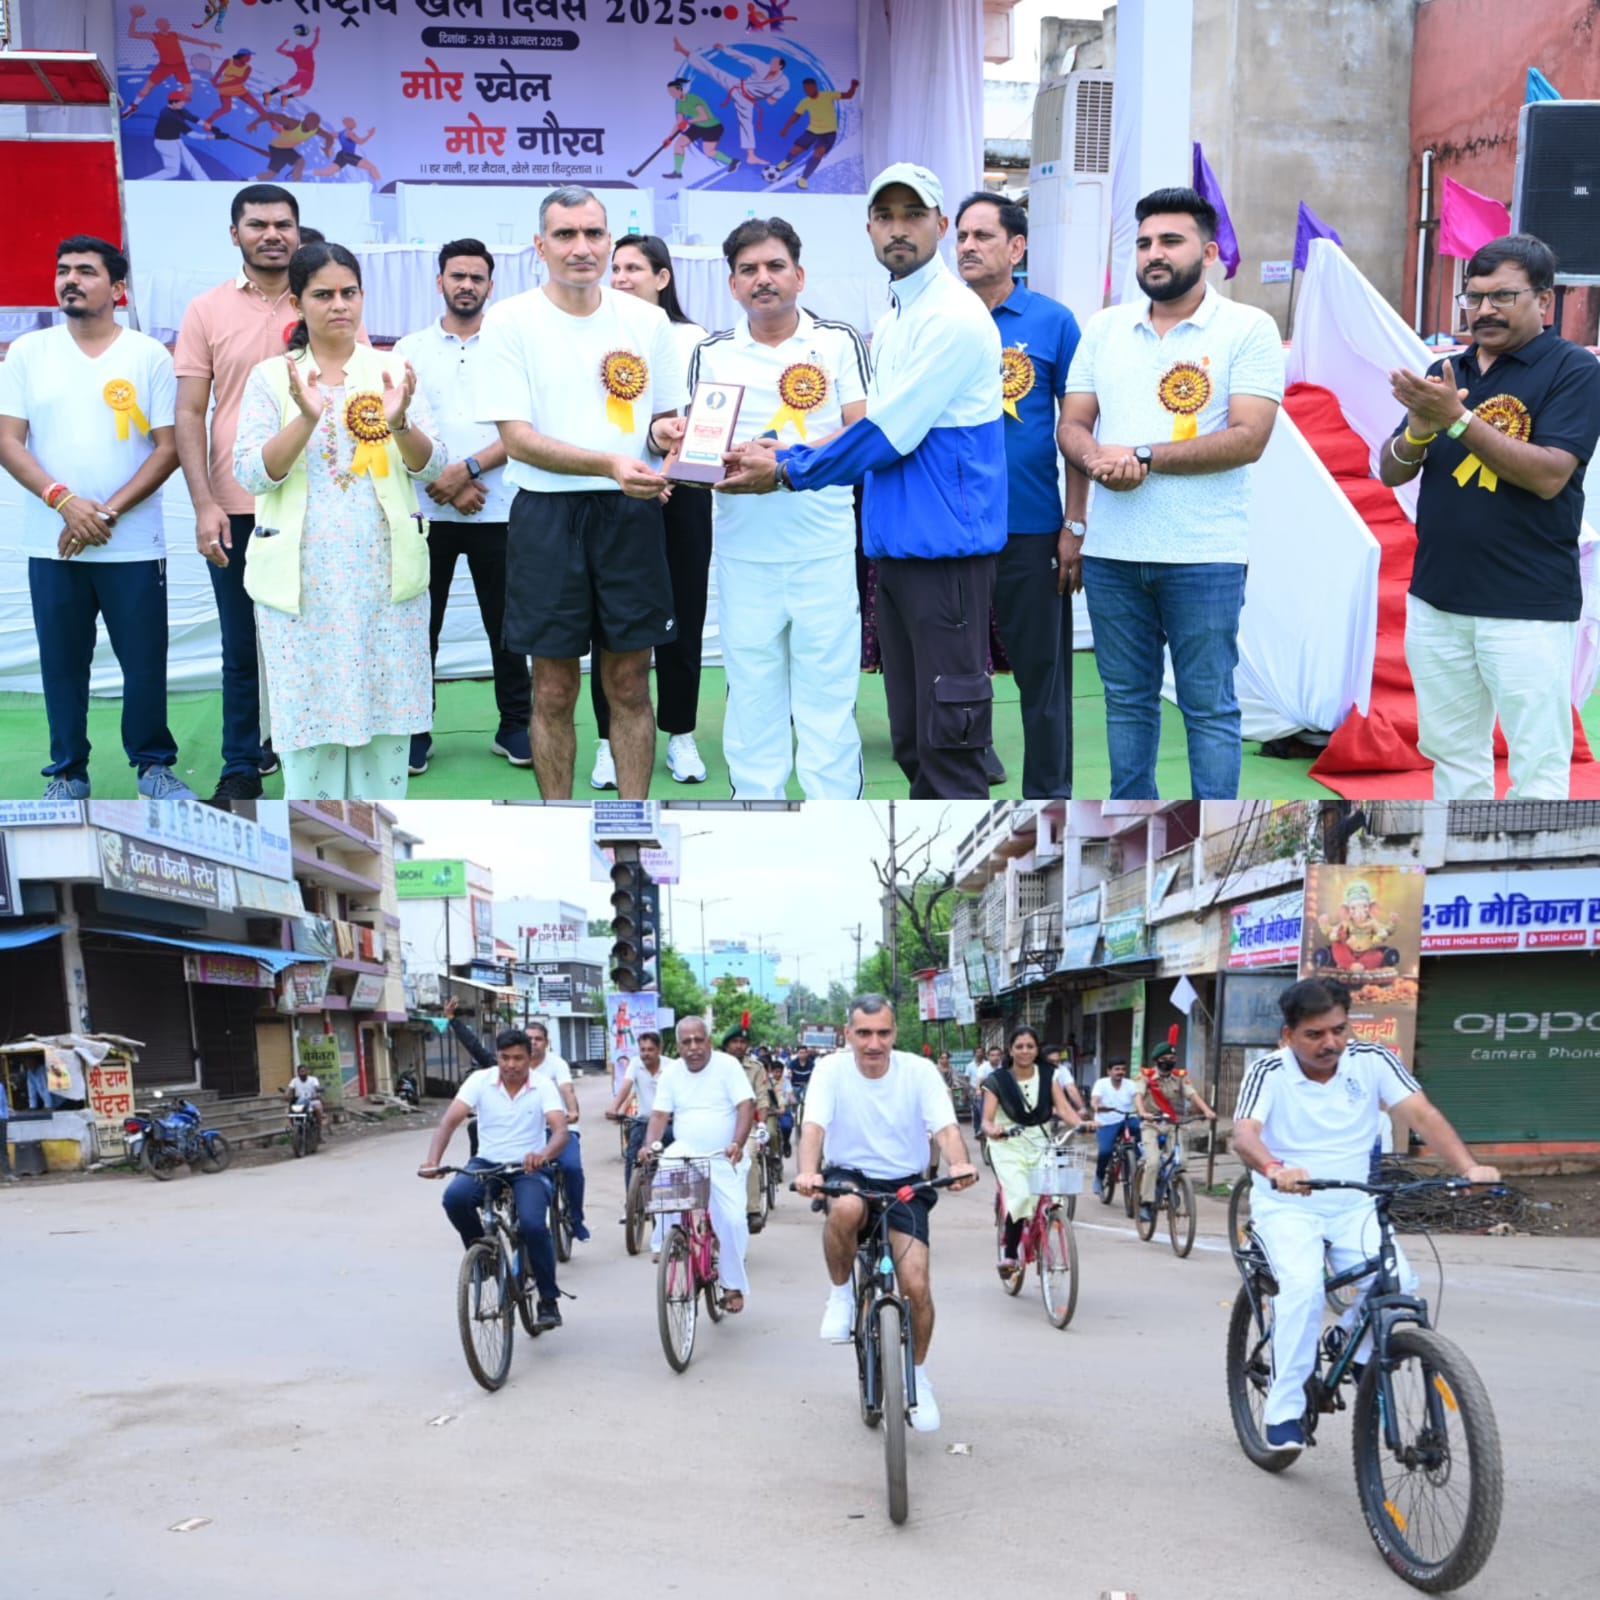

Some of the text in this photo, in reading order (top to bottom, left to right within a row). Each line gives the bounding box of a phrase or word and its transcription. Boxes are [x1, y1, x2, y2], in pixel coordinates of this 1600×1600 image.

[606, 0, 697, 25] 2025
[473, 34, 485, 45] 29
[498, 35, 508, 46] 31
[540, 36, 564, 47] 2025
[400, 56, 552, 103] मोर खेल
[444, 110, 606, 157] मोर गौरव
[1478, 892, 1585, 928] मेडिकल
[1431, 934, 1519, 947] FREE HOME DELIVERY
[1540, 932, 1560, 943] SKIN
[1562, 931, 1585, 942] CARE
[1471, 1047, 1537, 1060] Camera
[104, 1069, 129, 1088] राम
